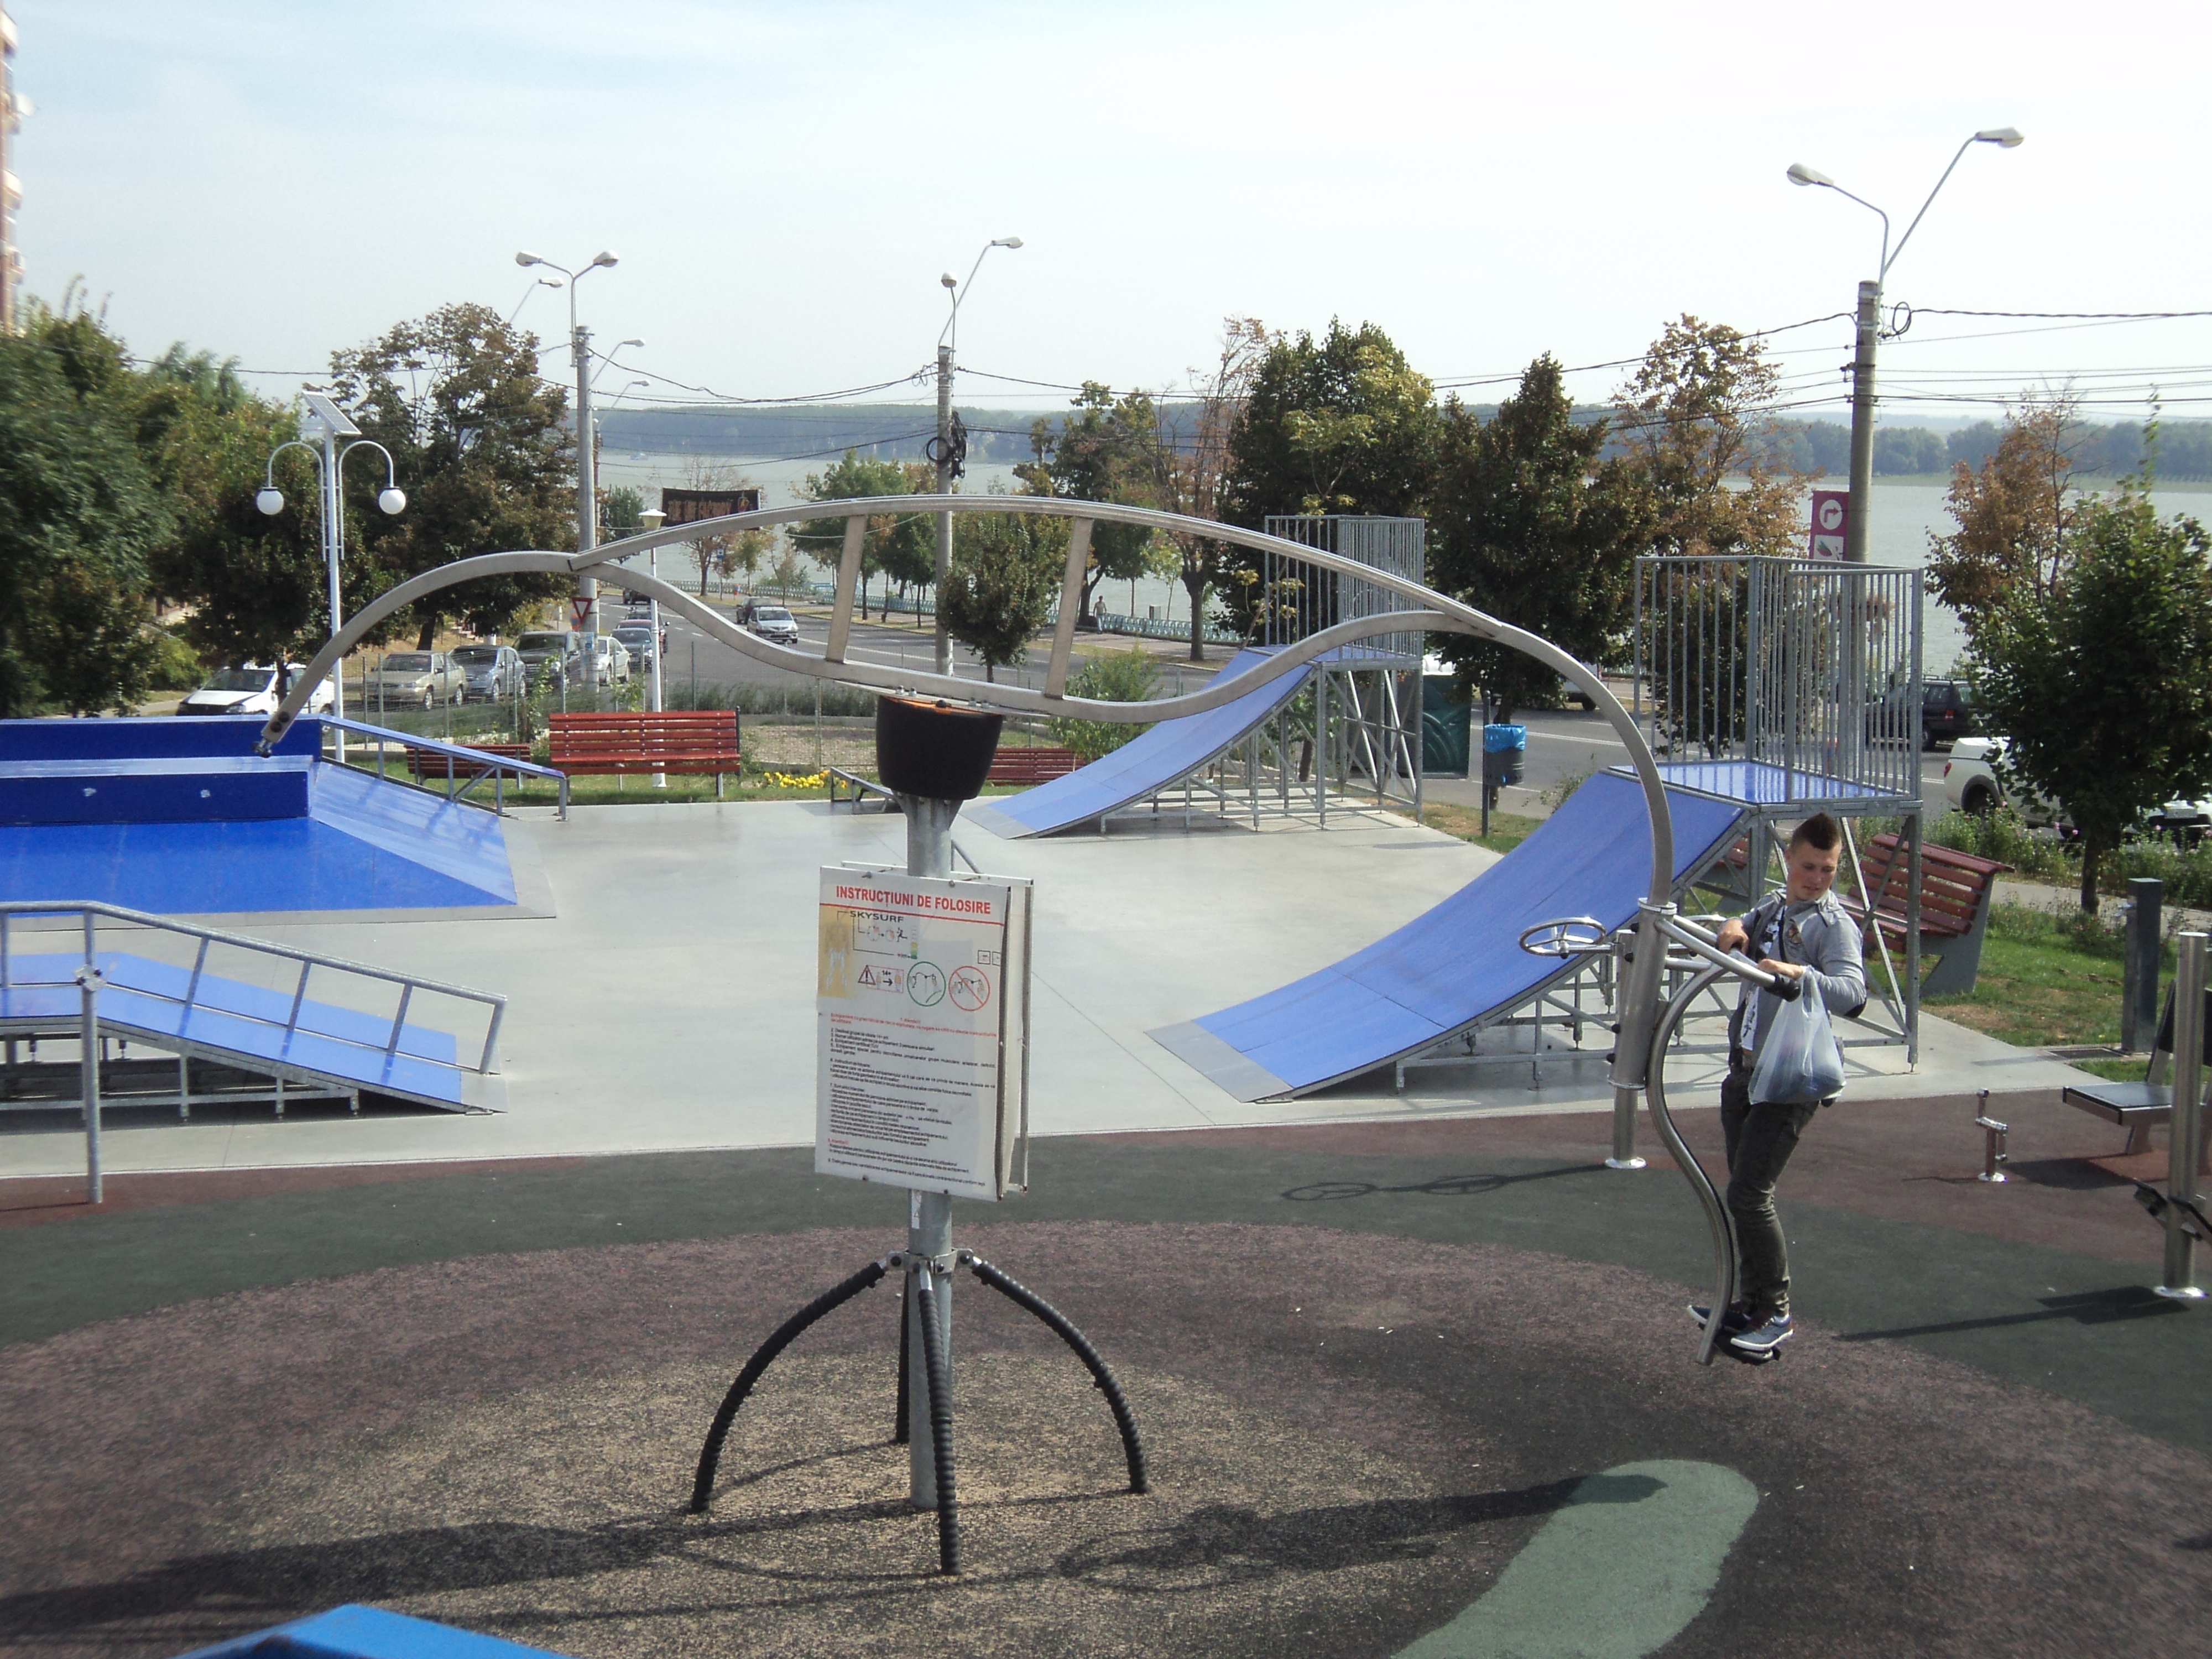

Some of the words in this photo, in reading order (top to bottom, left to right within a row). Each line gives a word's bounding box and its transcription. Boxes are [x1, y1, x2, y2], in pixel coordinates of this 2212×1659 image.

[917, 895, 931, 908] DE
[935, 896, 990, 914] FOLOSIRE
[850, 910, 904, 923] SKYSURF
